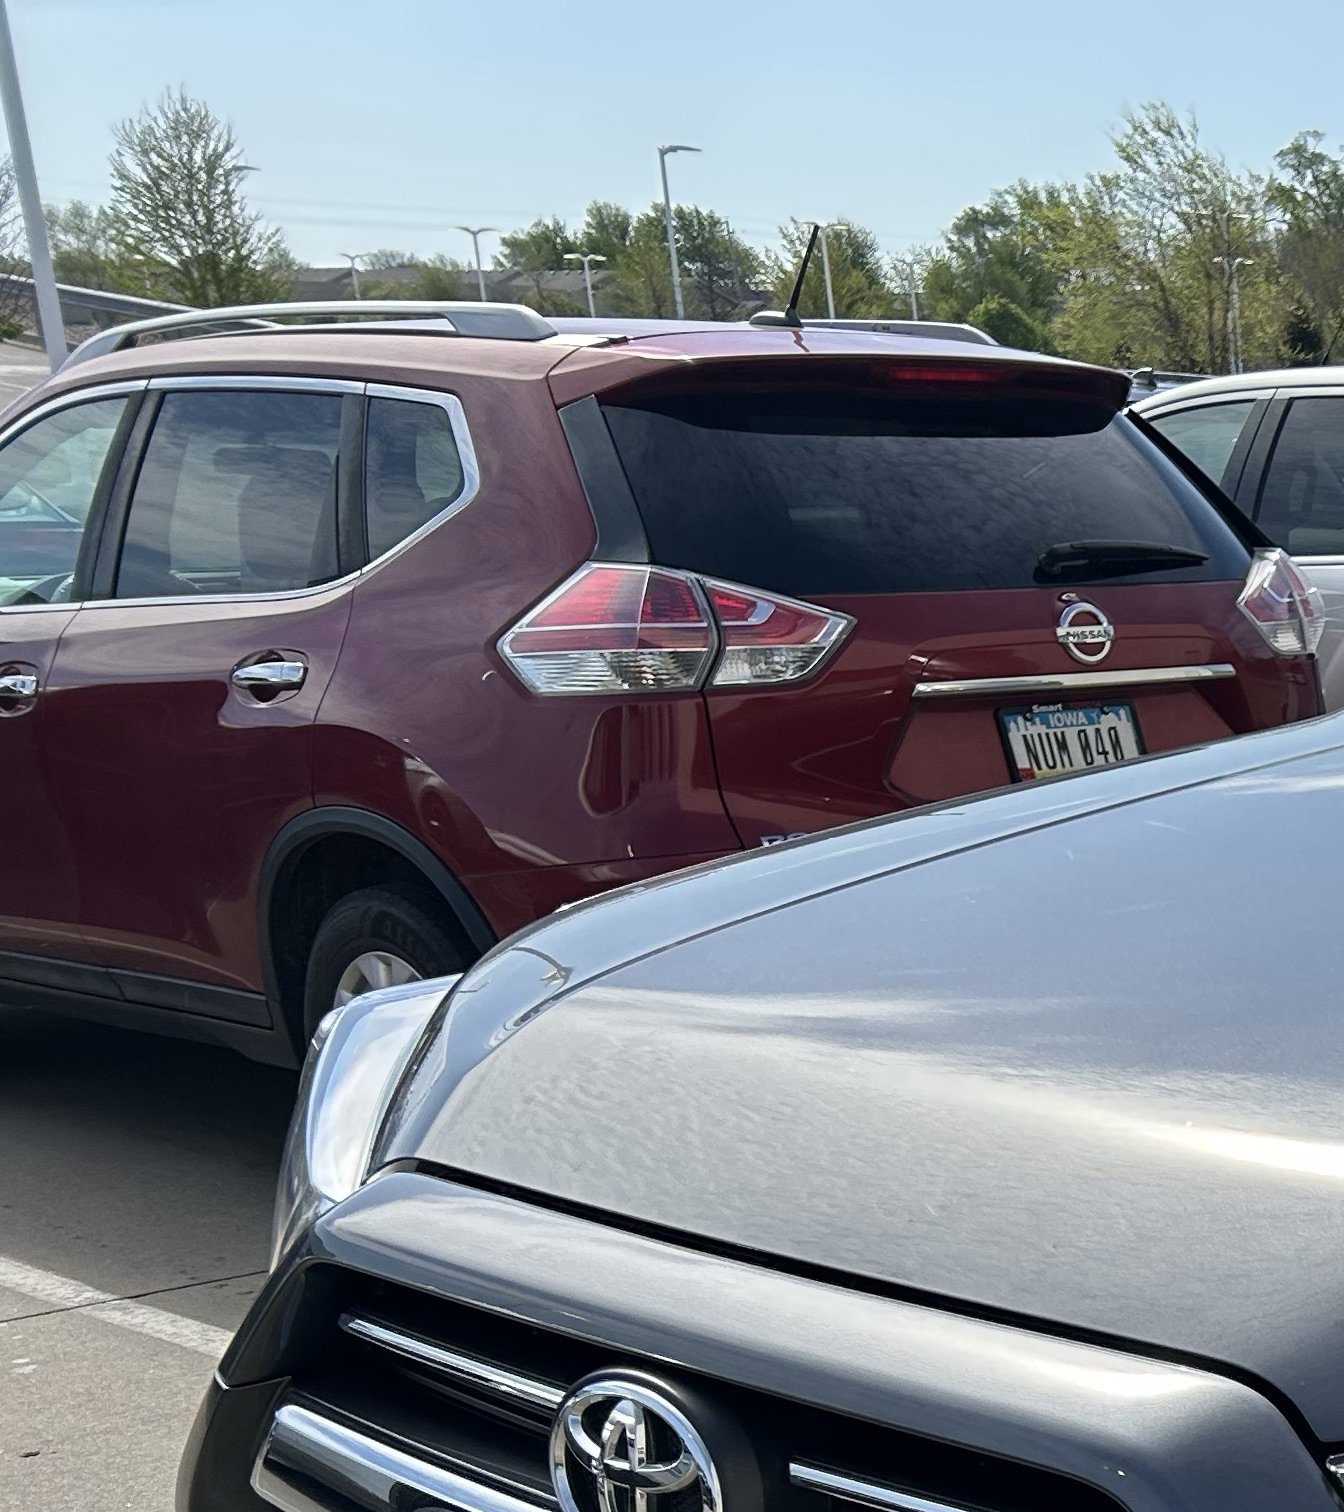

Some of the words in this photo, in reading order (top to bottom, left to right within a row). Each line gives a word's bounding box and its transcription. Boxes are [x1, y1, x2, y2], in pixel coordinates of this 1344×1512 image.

[1032, 703, 1063, 713] Smart
[1048, 711, 1088, 728] IOWA
[1021, 730, 1074, 771] NUM
[1077, 726, 1125, 767] 040
